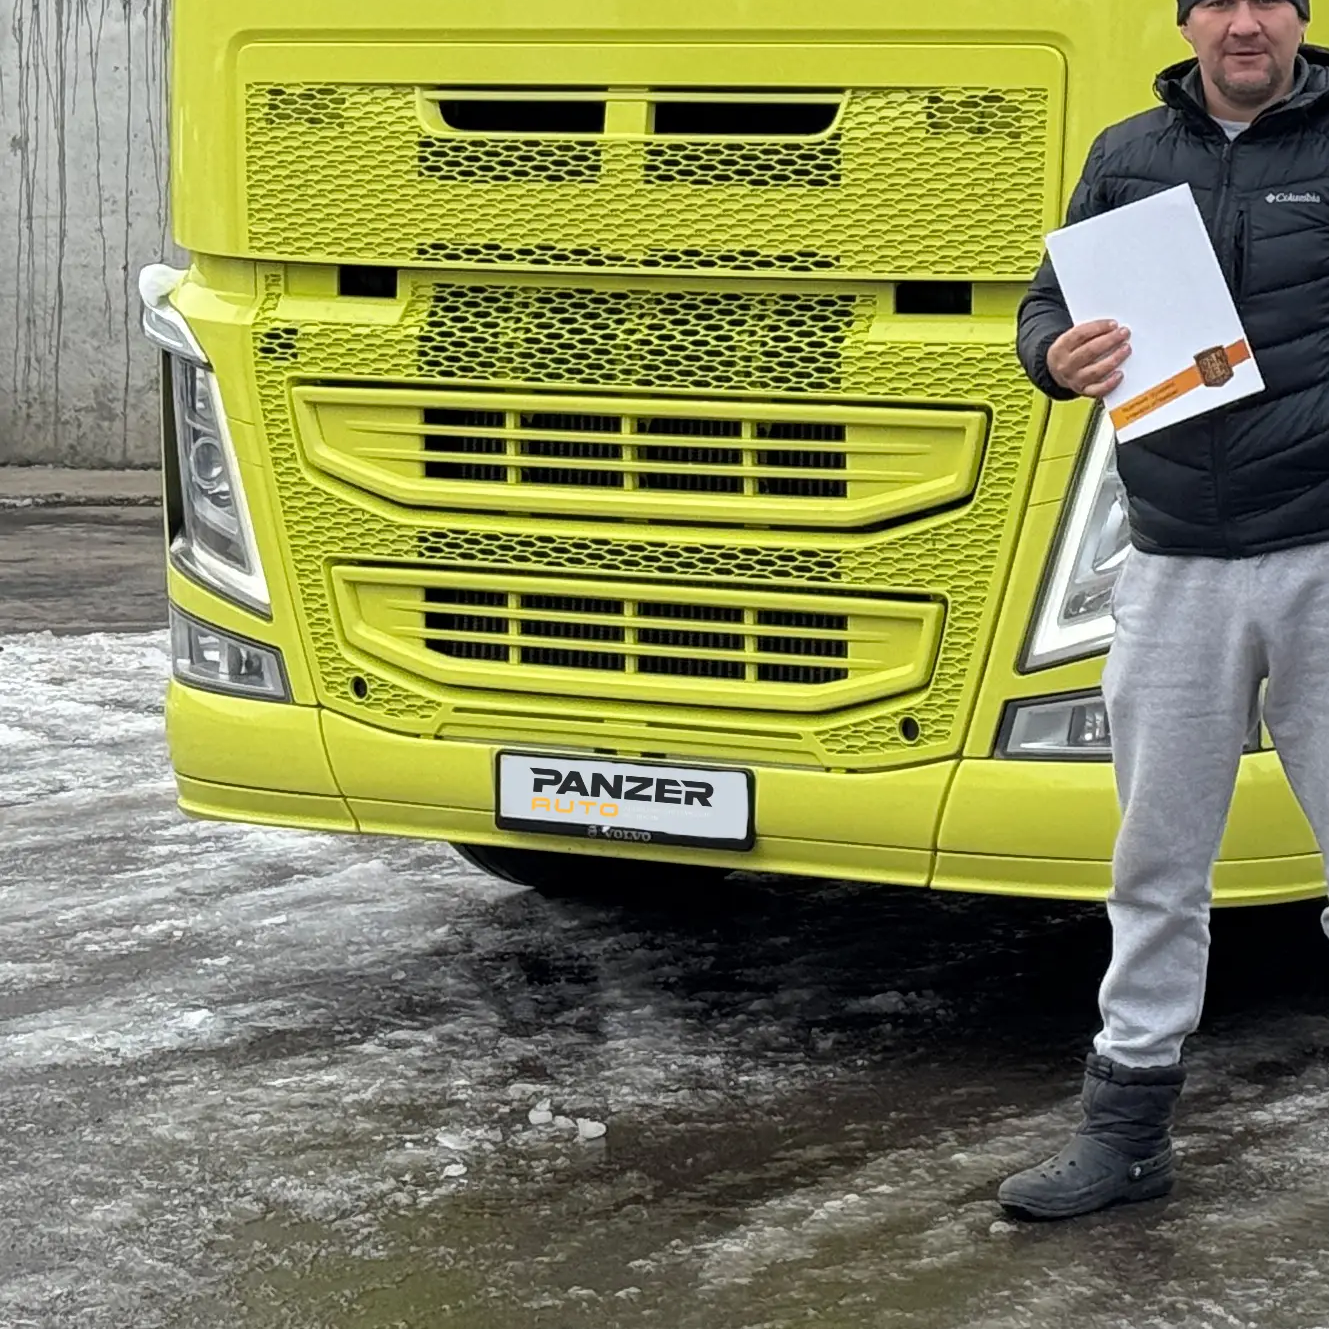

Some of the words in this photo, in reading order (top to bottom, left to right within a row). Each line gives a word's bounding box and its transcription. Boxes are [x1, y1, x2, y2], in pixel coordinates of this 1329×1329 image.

[1275, 191, 1321, 203] Columbia
[529, 767, 714, 808] PANZER
[531, 797, 619, 818] AUTO
[603, 826, 652, 842] VOLVO
